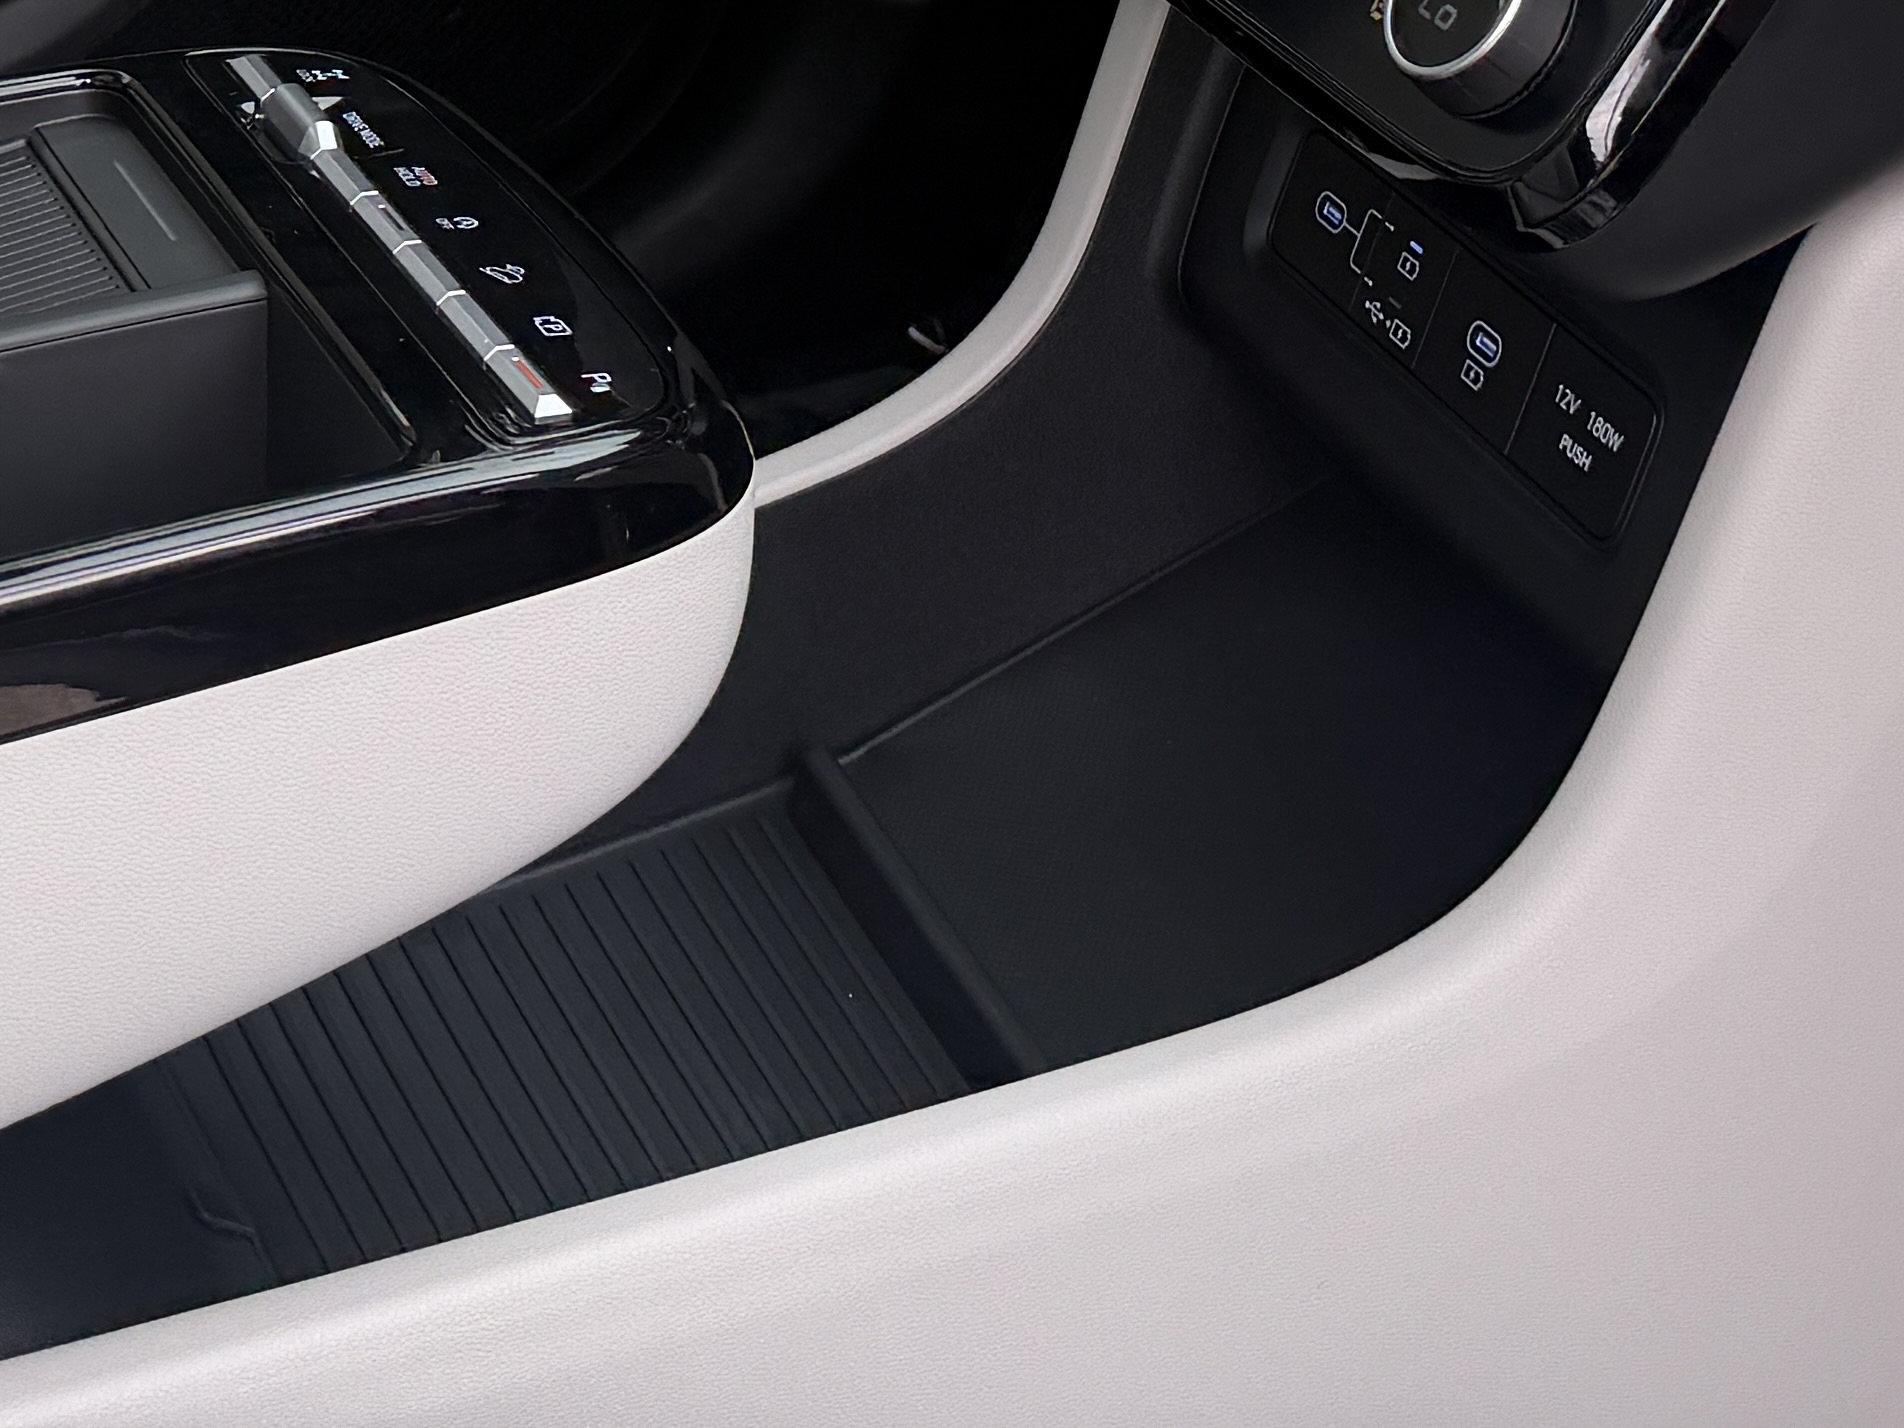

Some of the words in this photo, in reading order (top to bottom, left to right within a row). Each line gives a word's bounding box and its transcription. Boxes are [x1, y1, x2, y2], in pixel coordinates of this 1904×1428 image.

[1555, 384, 1582, 415] 12V
[1586, 410, 1626, 453] 180W
[1558, 433, 1593, 473] PUSH
